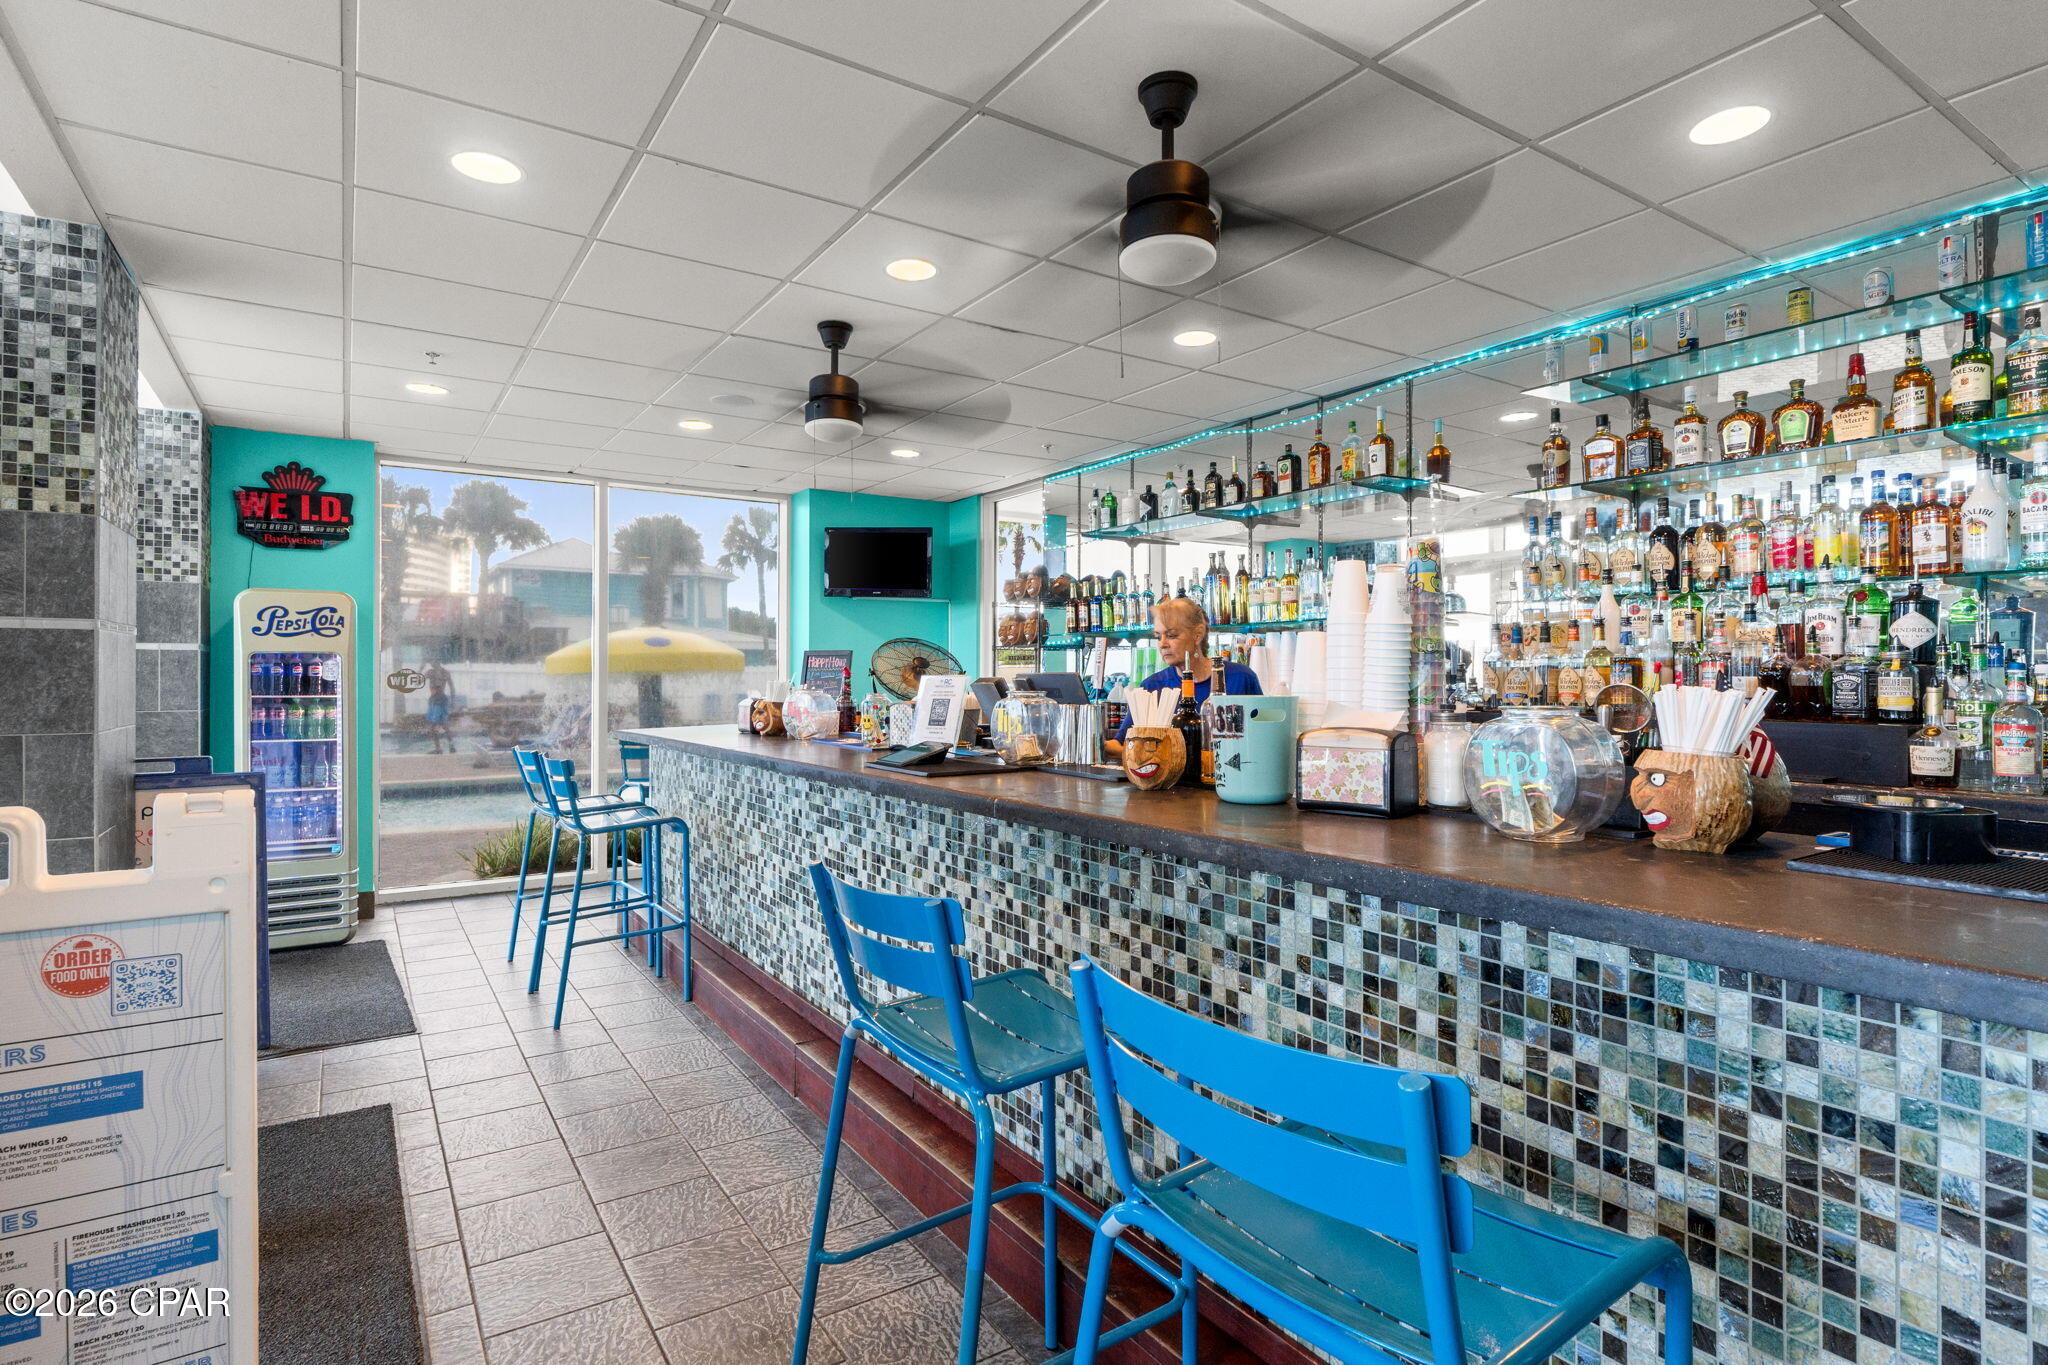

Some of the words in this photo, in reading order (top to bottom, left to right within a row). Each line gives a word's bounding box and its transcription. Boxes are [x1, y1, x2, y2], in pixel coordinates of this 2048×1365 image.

[1835, 410, 1870, 421] Maker's
[1843, 416, 1870, 424] Mark
[236, 491, 288, 519] WE
[301, 495, 349, 522] I.D.
[263, 533, 325, 545] Budweiser
[1818, 613, 1837, 624] BEAM
[997, 708, 1022, 742] Tips
[1215, 705, 1244, 733] SH
[1471, 739, 1550, 796] Tips
[54, 948, 111, 968] ORDER
[51, 970, 77, 984] FOOD
[80, 968, 109, 980] ONLIN
[2, 1044, 46, 1068] RS
[24, 1087, 59, 1099] CHEESE
[62, 1082, 86, 1093] FRIES
[26, 1096, 57, 1106] FAVORITE
[58, 1092, 80, 1100] CRISPY
[99, 1082, 136, 1093] SMOTHERED
[2, 1108, 26, 1117] QUESO
[50, 1099, 81, 1108] CHEDDAR
[82, 1095, 99, 1103] JACK
[24, 1111, 49, 1119] CHIVES
[9, 1151, 32, 1159] POUND
[43, 1145, 64, 1153] HOUSE
[65, 1140, 94, 1149] ORIGINAL
[19, 1139, 50, 1150] WINGS
[56, 1136, 68, 1144] 20
[39, 1152, 63, 1160] TOSSED
[72, 1146, 90, 1154] YOUR
[91, 1142, 114, 1150] CHOICE
[61, 1154, 84, 1163] GARLIC
[5, 1170, 41, 1181] NASHVILLE
[72, 1227, 114, 1240] FIREHOUSE
[116, 1214, 171, 1231] SMASHBURGER
[89, 1241, 105, 1250] FRIED
[186, 1217, 210, 1227] CANDIED
[100, 1233, 120, 1242] SEARED
[121, 1230, 134, 1238] BEEF
[135, 1225, 156, 1235] PATTIES
[156, 1220, 177, 1230] TOPPED
[177, 1216, 190, 1224] WITH
[190, 1212, 209, 1221] PEPPER
[87, 1246, 110, 1256] SMOKED
[132, 1238, 144, 1246] AND
[145, 1234, 160, 1243] SPICY
[161, 1229, 178, 1239] RANCH
[170, 1244, 192, 1252] TOASTED
[5, 1250, 14, 1258] 19
[72, 1262, 87, 1271] THE
[89, 1253, 126, 1266] ORIGINAL
[127, 1240, 181, 1258] SMASHBURGER
[6, 1263, 28, 1272] SAUCE
[4, 1283, 15, 1291] 20
[120, 1284, 143, 1294] TACOS
[74, 1337, 99, 1347] BEACH
[101, 1329, 129, 1340] PO'BOY
